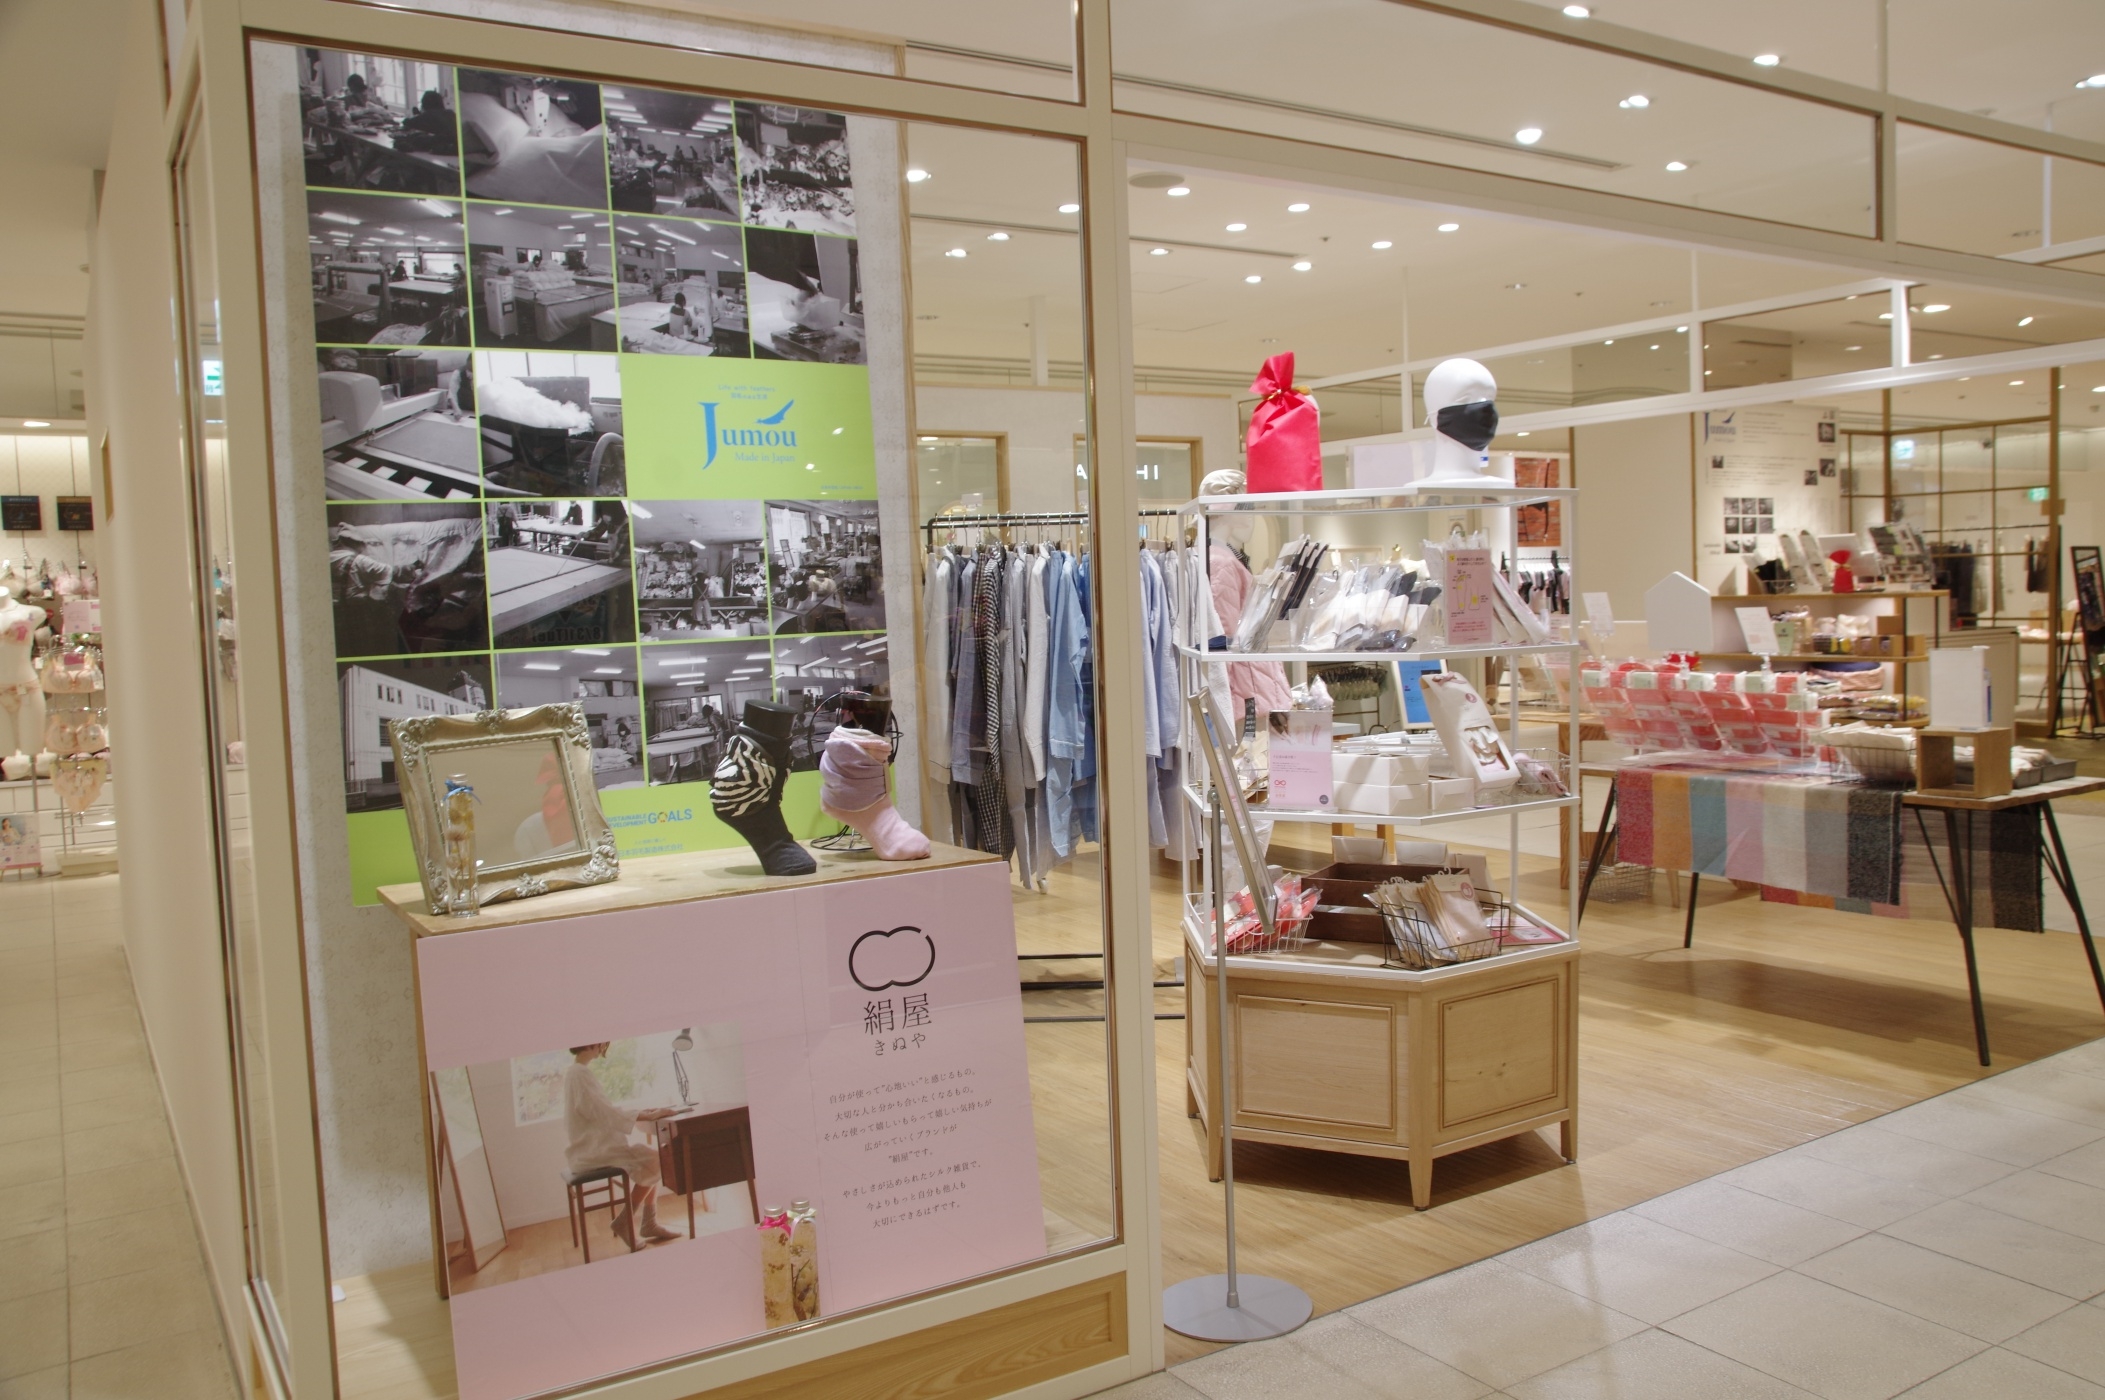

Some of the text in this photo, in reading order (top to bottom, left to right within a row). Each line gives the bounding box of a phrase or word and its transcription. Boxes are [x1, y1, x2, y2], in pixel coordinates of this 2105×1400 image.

[697, 401, 798, 470] Jumou
[735, 452, 796, 464] Made in Japan
[648, 807, 693, 825] GOALS
[864, 993, 932, 1035] 絹屋
[874, 1033, 927, 1056] きぬや
[835, 1086, 974, 1122] 大切な人と分かち合いたくなるもの。
[864, 1123, 957, 1152] 広がっていくブランドが
[873, 1200, 960, 1229] 大切にできるはずです。
